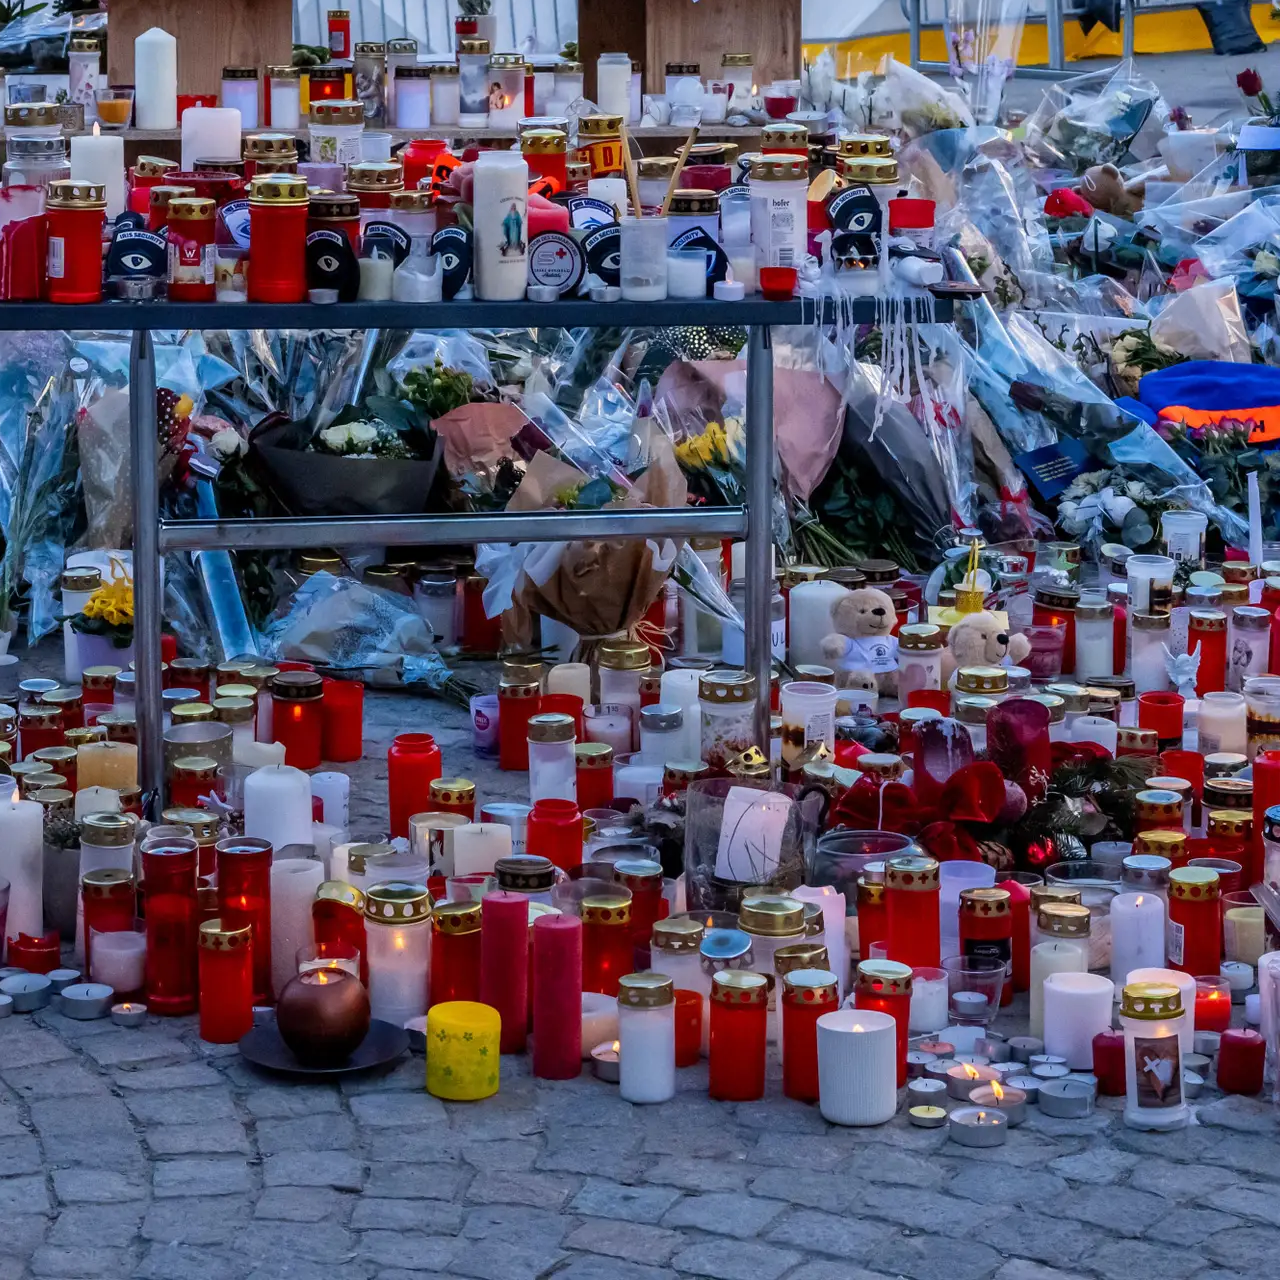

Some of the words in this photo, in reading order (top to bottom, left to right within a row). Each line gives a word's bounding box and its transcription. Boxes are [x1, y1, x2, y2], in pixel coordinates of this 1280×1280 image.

[728, 188, 751, 196] SECURIT
[839, 189, 866, 205] SECURITY
[772, 199, 790, 207] hofer
[119, 232, 133, 240] IRIS
[133, 232, 164, 247] SECURITY
[587, 232, 600, 247] IRIS
[184, 249, 196, 258] W
